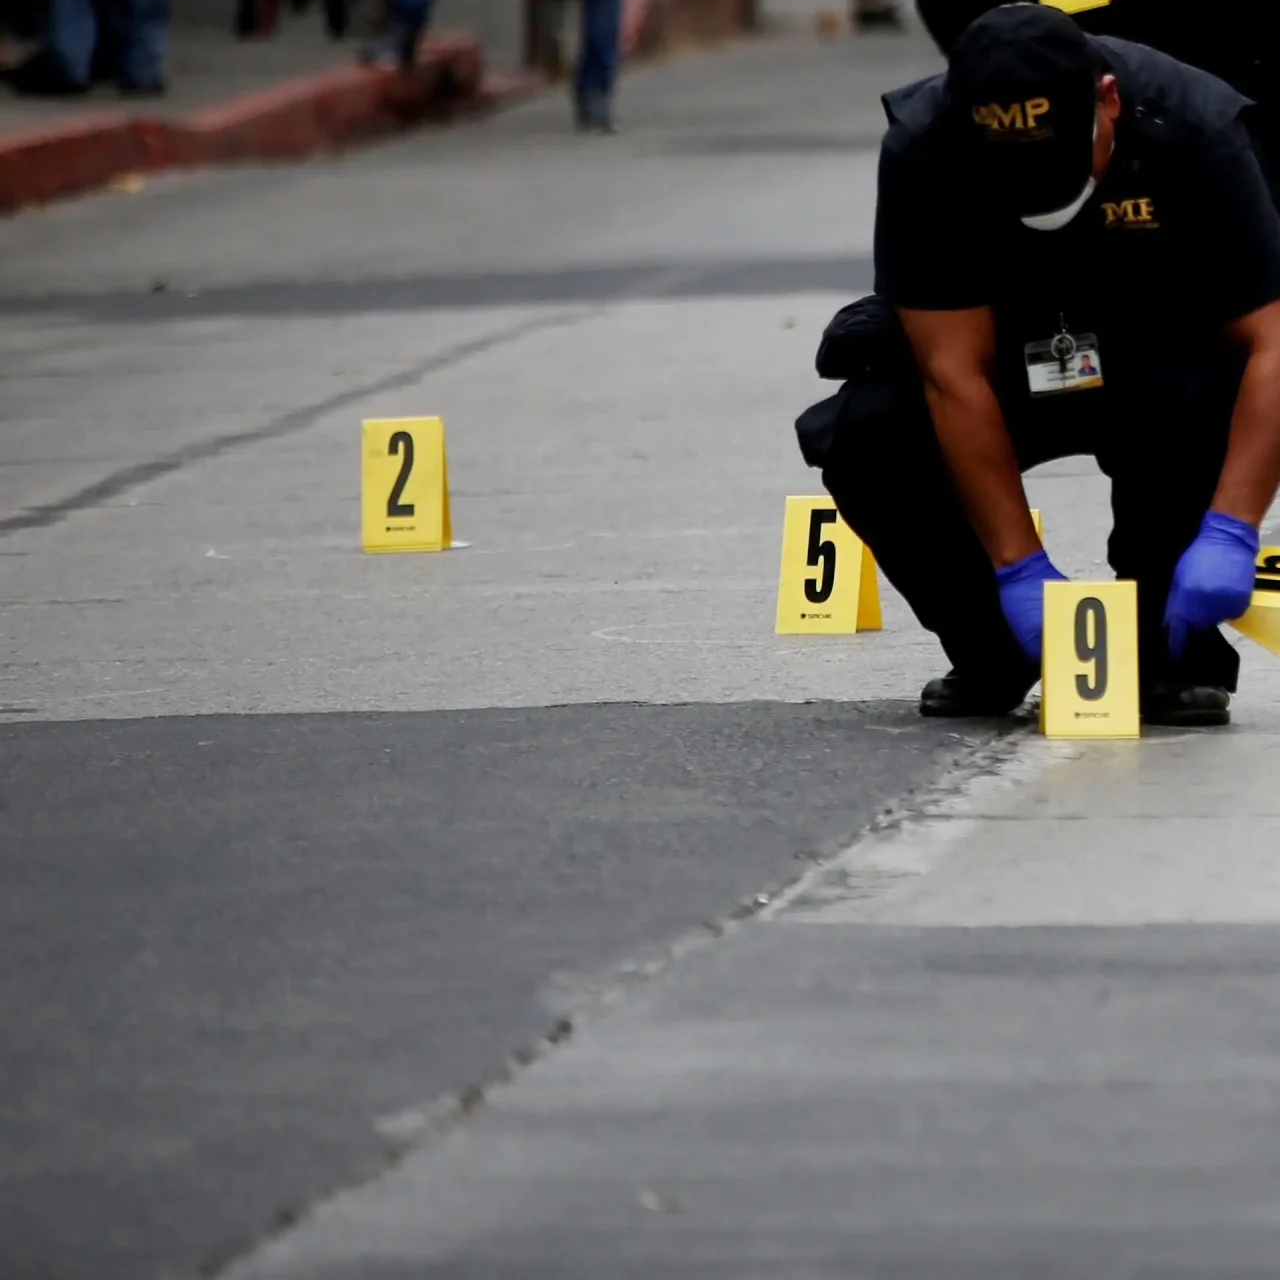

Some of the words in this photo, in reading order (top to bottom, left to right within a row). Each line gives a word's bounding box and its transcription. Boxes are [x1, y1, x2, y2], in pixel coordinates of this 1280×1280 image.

[990, 97, 1050, 130] MP
[387, 431, 415, 517] 2
[804, 509, 837, 604] 5
[1074, 597, 1108, 701] 9
